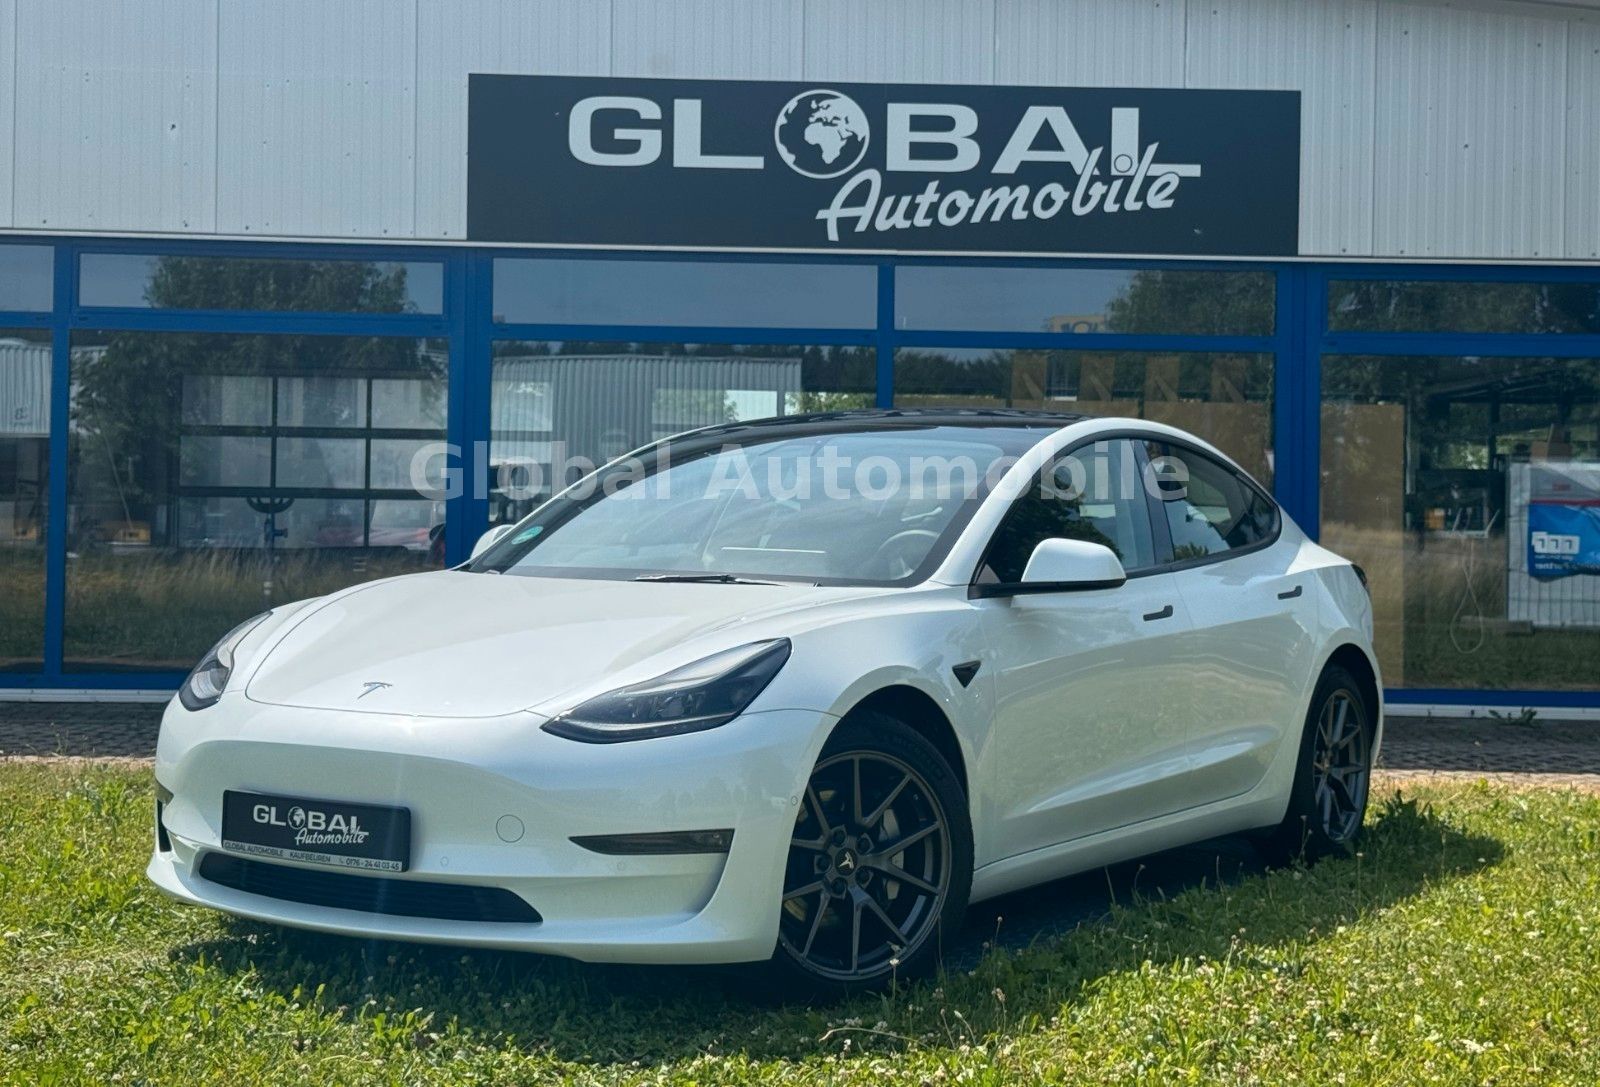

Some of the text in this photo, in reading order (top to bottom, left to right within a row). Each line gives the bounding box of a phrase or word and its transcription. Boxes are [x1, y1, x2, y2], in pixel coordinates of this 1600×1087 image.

[568, 88, 1201, 179] GLOBAL
[815, 142, 1181, 242] Automobile
[253, 804, 370, 836] GLOBAL
[294, 825, 365, 846] Automobile
[224, 842, 246, 852] GLOBAL
[248, 845, 284, 856] AUTOMOBILE
[289, 851, 331, 862] KAUFBEUREN
